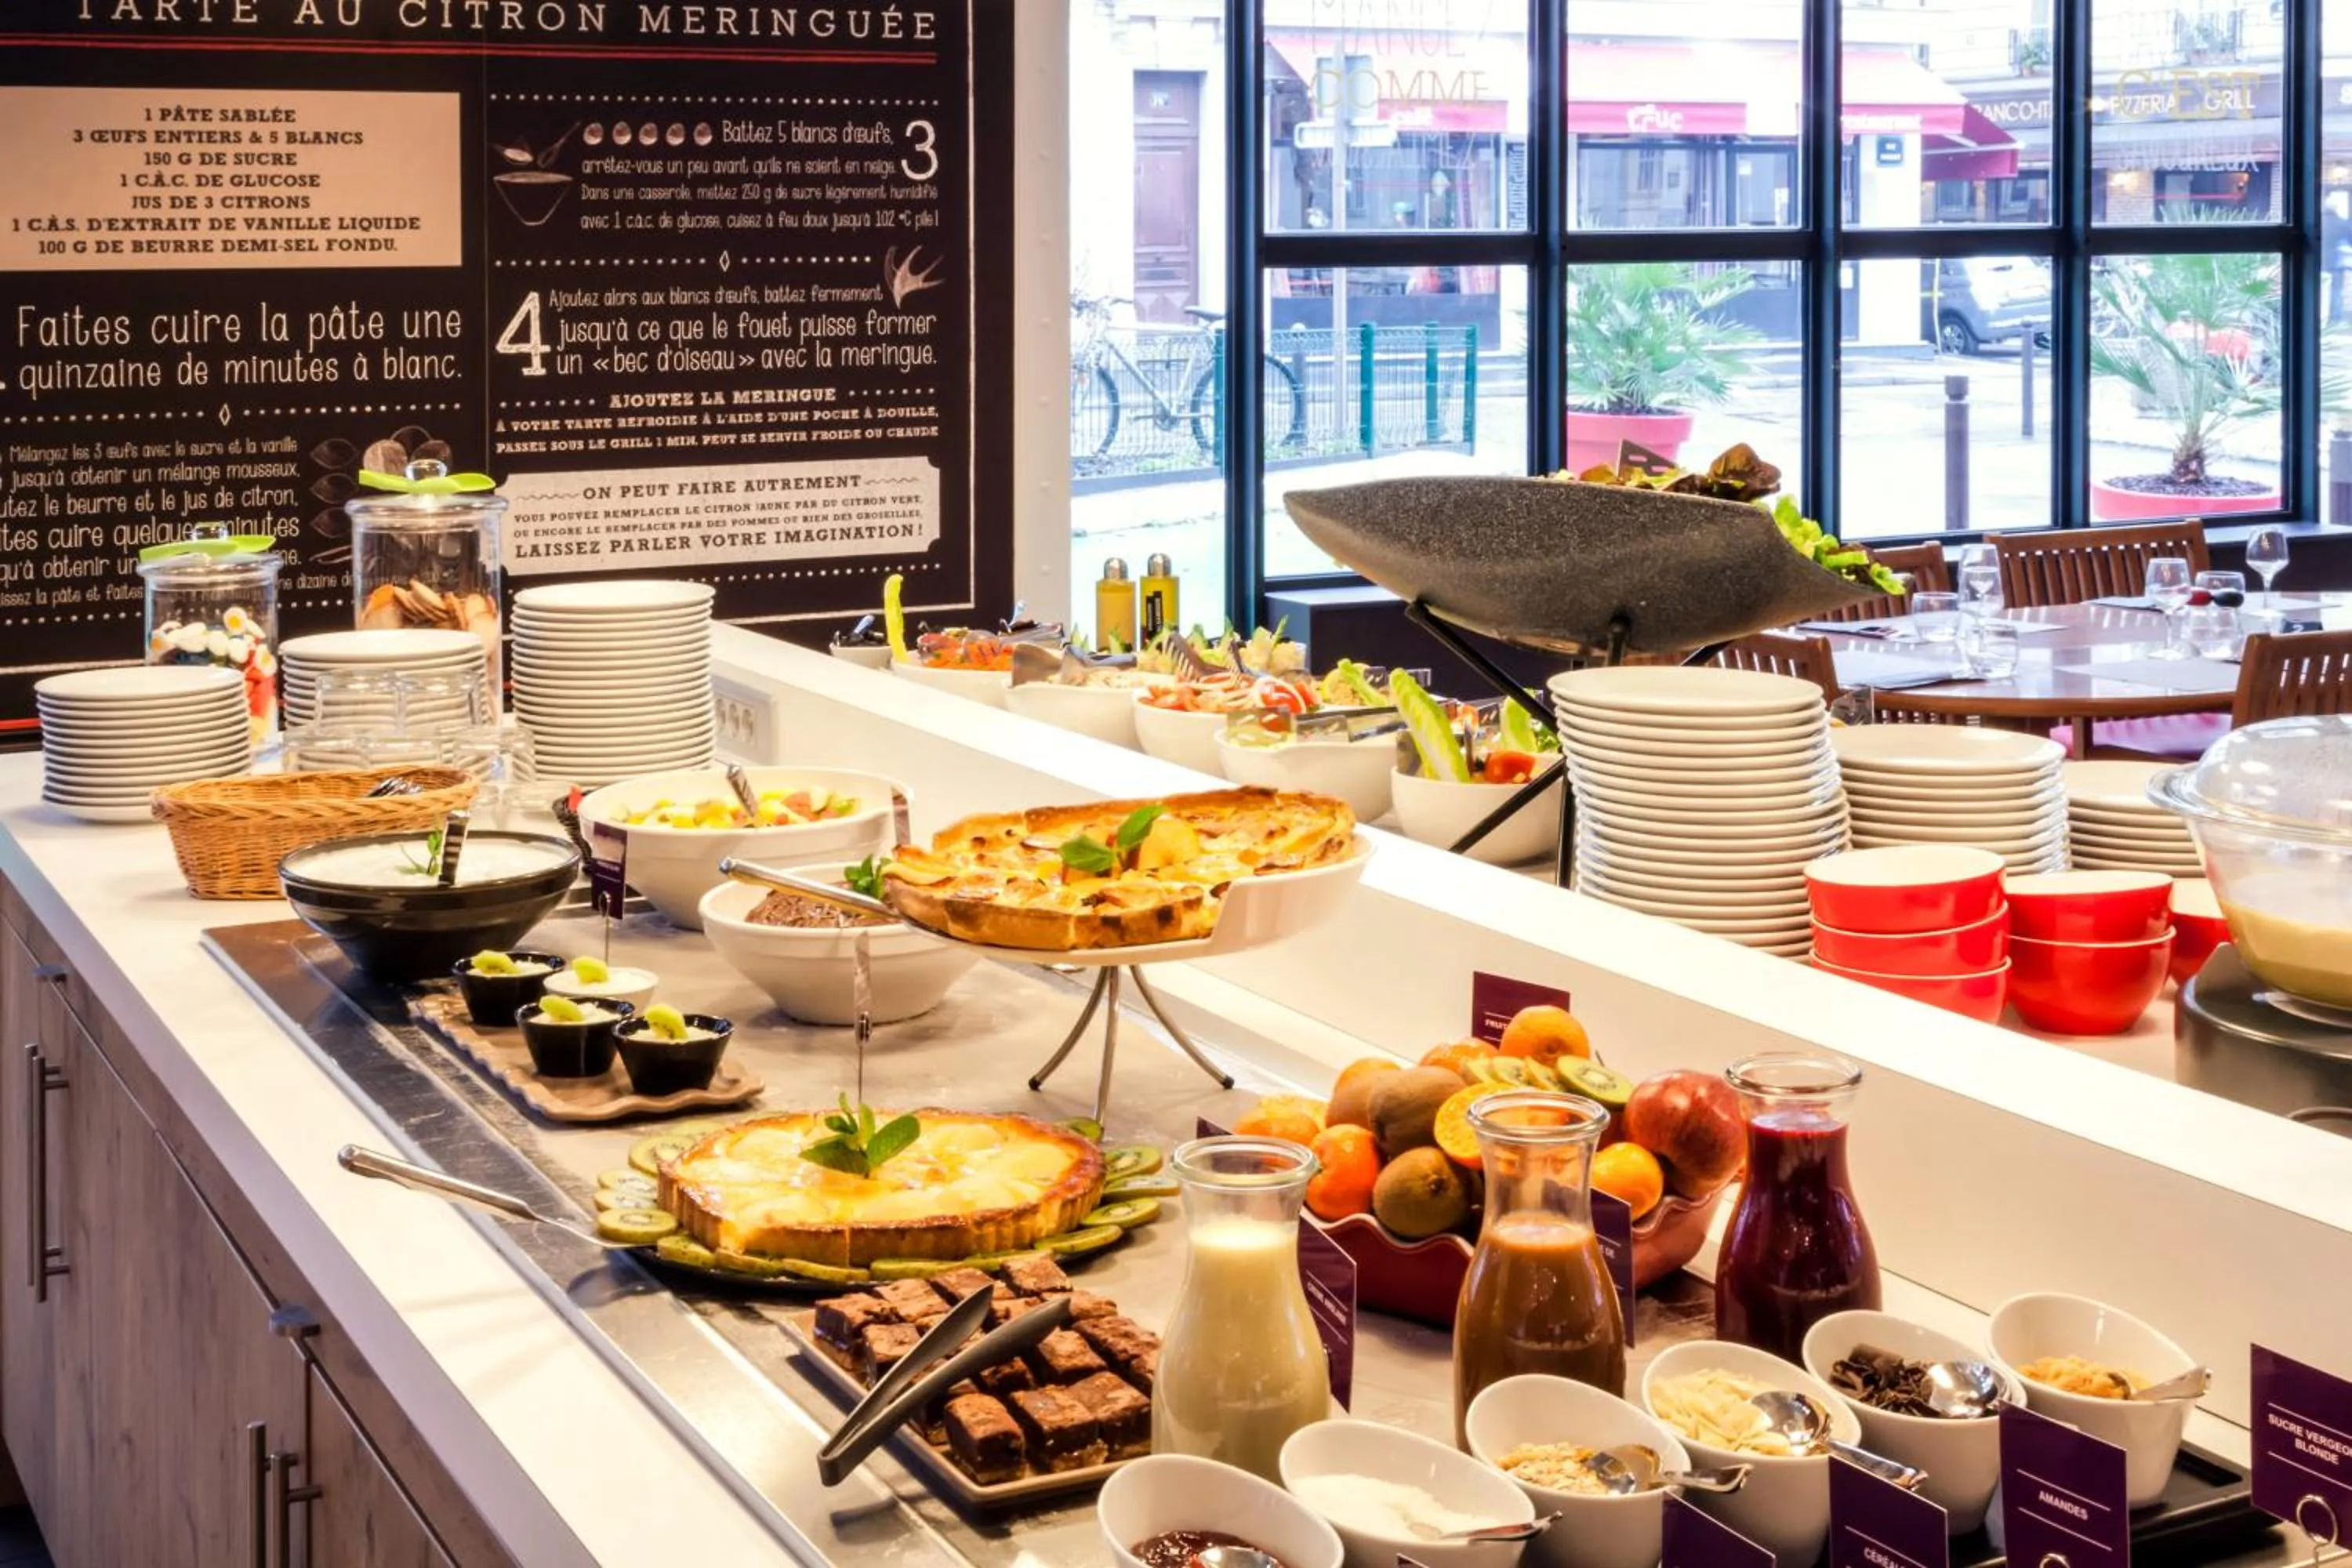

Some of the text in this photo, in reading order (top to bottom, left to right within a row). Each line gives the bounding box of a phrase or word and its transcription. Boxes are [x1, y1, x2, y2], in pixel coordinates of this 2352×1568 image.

[293, 0, 361, 25] AU
[399, 1, 605, 31] CITRON
[640, 5, 935, 38] MERINGUÉE
[2204, 88, 2256, 111] GRILL
[144, 105, 296, 123] 1 PÂTE SABLÉE
[72, 129, 364, 145] 3 ŒUFS ENTIERS & 5 BLANCS
[722, 120, 894, 144] Battez 5 blancs d'œufs,
[143, 151, 297, 166] 150 G DE SUCRE
[902, 120, 939, 181] 3
[120, 173, 128, 187] 1
[194, 173, 223, 187] DE
[229, 173, 321, 187] GLUCOSE
[581, 157, 860, 179] arrêtez-vous un peu avant ne soient en
[131, 195, 311, 209] JUS DE 3 CITRONS
[12, 217, 21, 233] 1
[86, 217, 201, 232] D'EXTRAIT
[208, 217, 236, 231] DE
[242, 216, 332, 231] VANILLE
[338, 216, 421, 232] LIQUIDE
[38, 240, 67, 255] 100
[71, 240, 88, 254] G
[94, 239, 125, 254] DE
[131, 239, 214, 254] BEURRE
[220, 238, 319, 252] DEMI-SEL
[548, 285, 884, 312] Ajoutez alors aux blancs d'œufs, battez fermement
[18, 302, 462, 355] Faites cuire la pâte une
[495, 291, 551, 376] 4
[557, 309, 937, 351] jusqu'à ce que le fouet puisse former
[556, 340, 937, 376] un bec d'oiseau avec la meringue.
[19, 347, 462, 401] quinzaine de minutes à blanc.
[609, 388, 837, 408] AJOUTEZ LA MERINGUE
[9, 436, 298, 466] Mélangez les œufs avec le sucre et la vanille
[9, 461, 300, 495] jusqu'à obtenir un mélange mousseux.
[583, 474, 862, 500] ON PEUT FAIRE AUTREMENT
[45, 483, 299, 517] le beurre et le jus de citron.
[48, 524, 103, 549] cuire
[515, 540, 601, 558] LAISSEZ
[609, 535, 691, 553] PARLER
[699, 532, 767, 548] VOTRE
[2268, 1414, 2303, 1437] SUCRE
[2295, 1437, 2339, 1465] BLONDE
[2038, 1490, 2089, 1520] AMANDES
